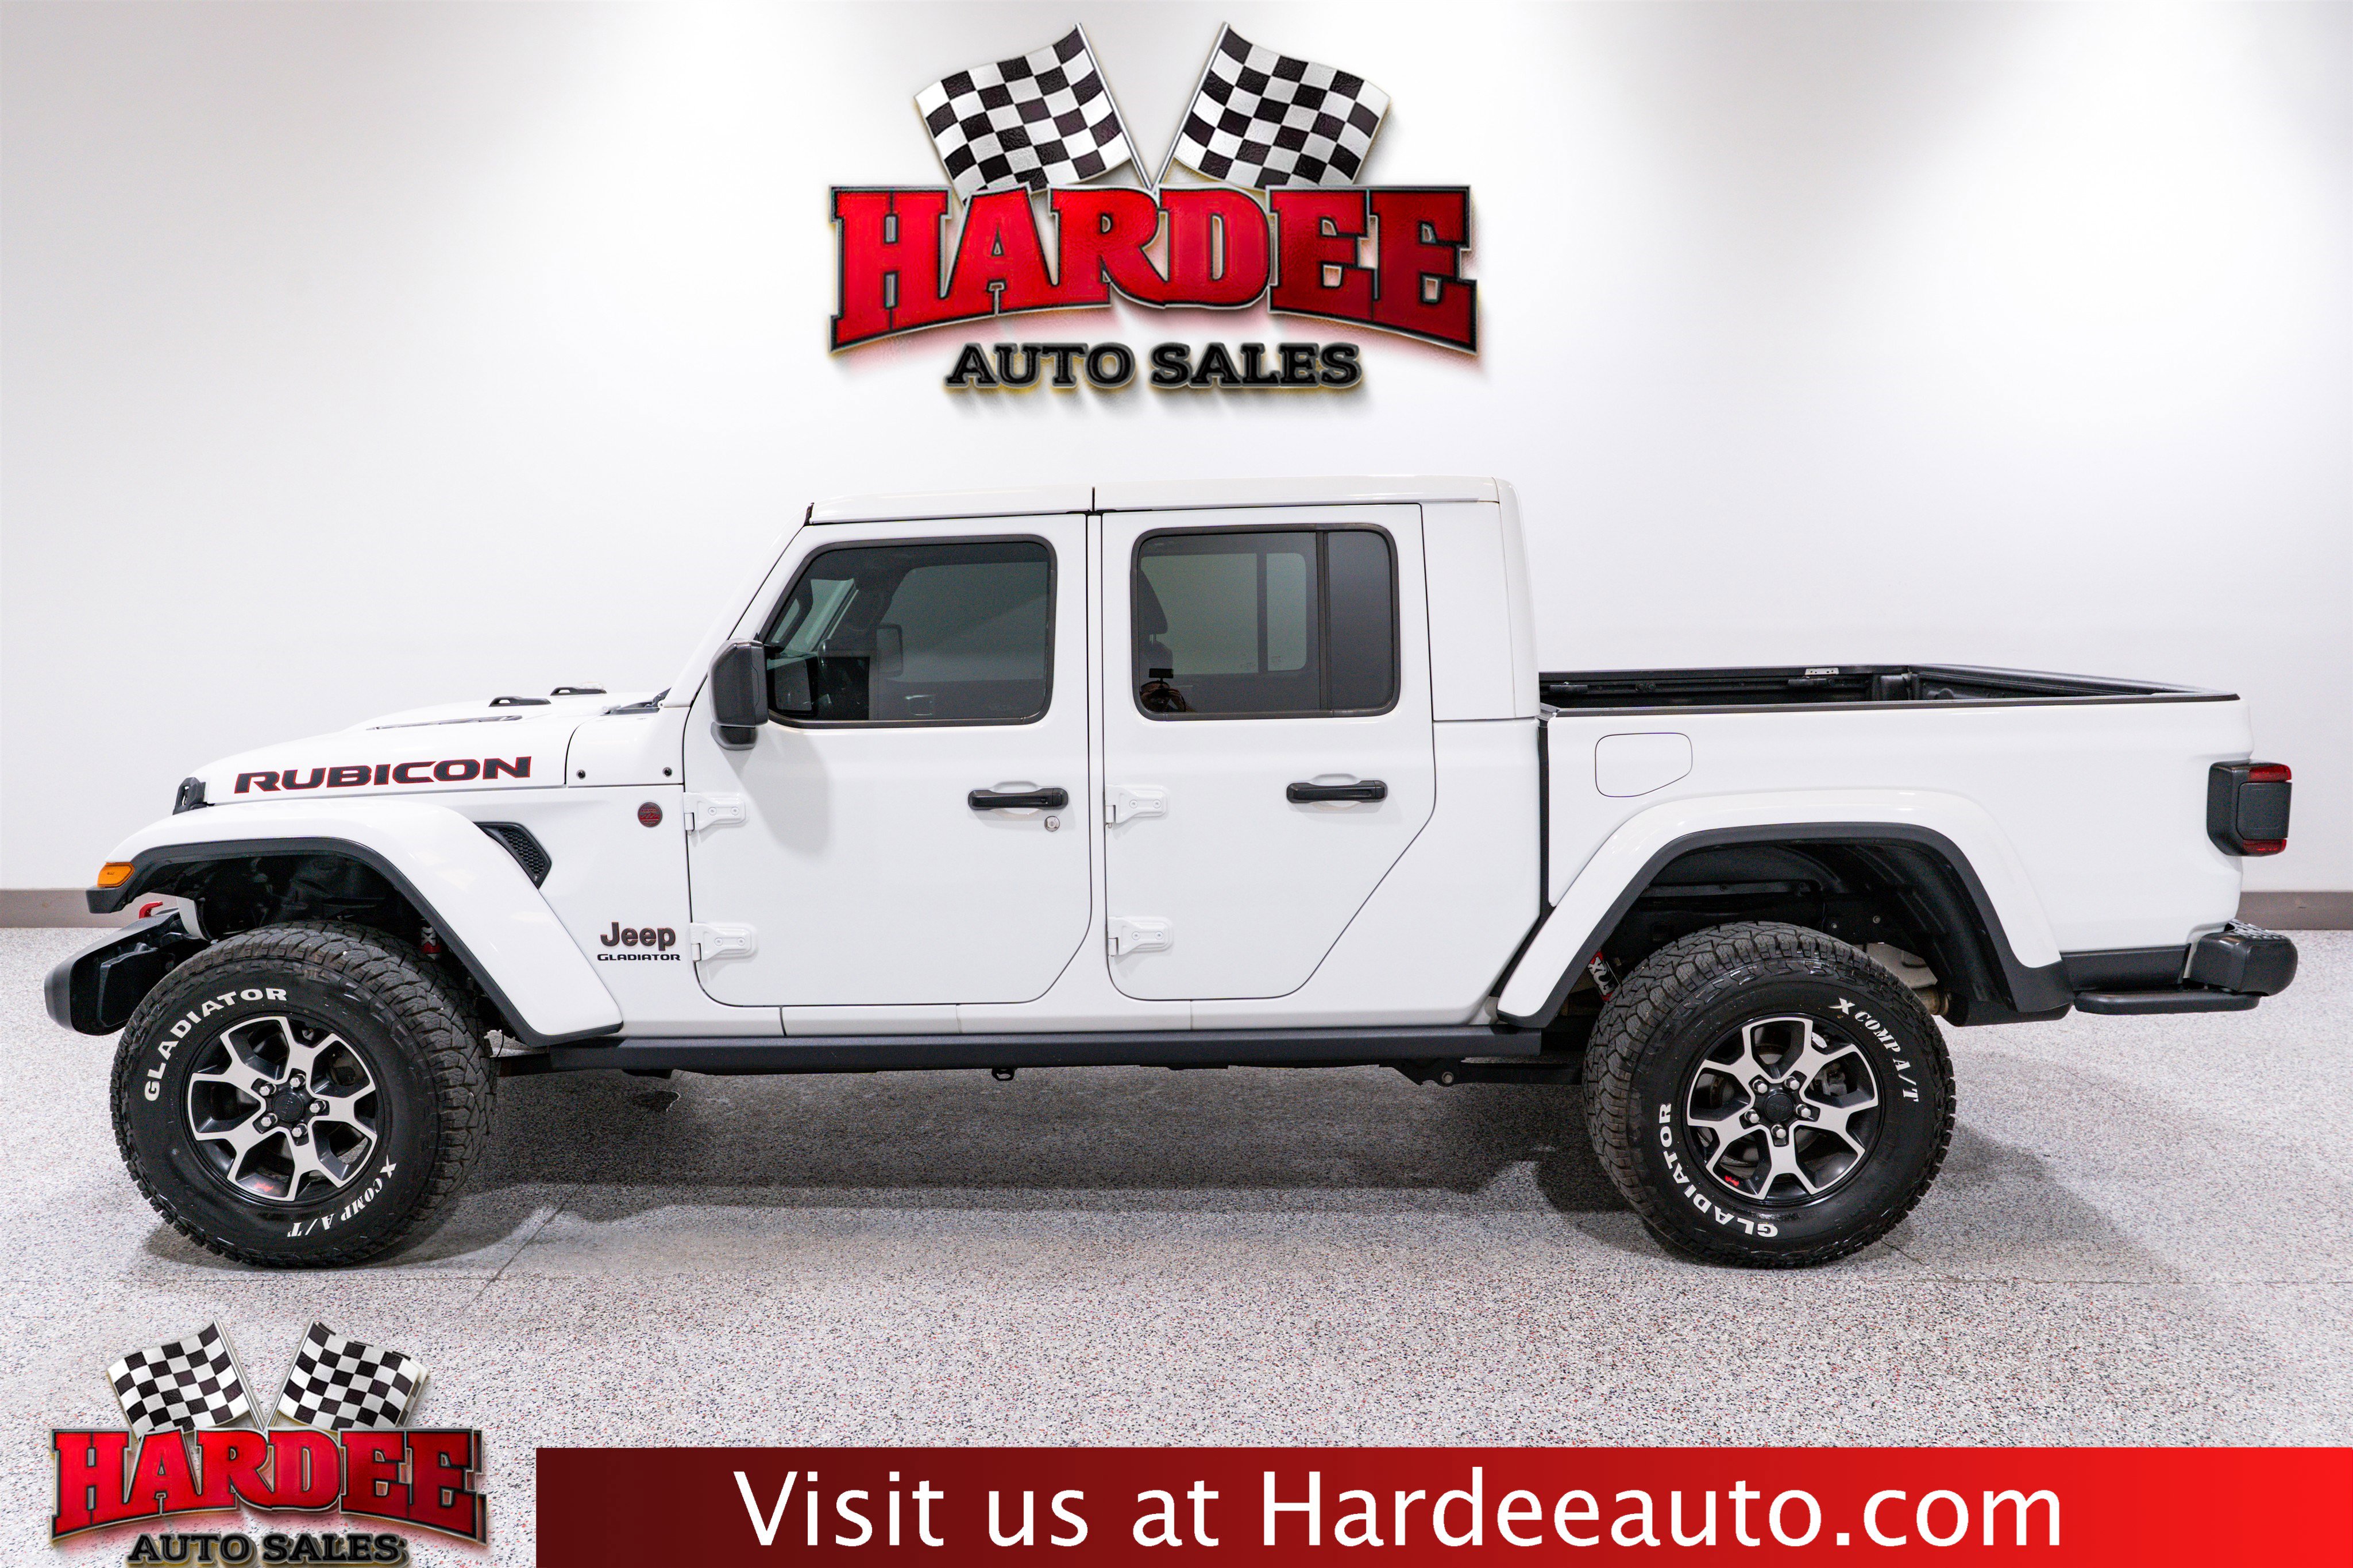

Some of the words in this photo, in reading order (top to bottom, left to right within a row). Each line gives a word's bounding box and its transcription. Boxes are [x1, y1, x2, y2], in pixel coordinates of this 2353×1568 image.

[829, 184, 1479, 355] HARDEE
[946, 342, 1136, 389] AUTO
[1150, 342, 1363, 389] SALES
[234, 756, 532, 794] RUBICON
[596, 953, 681, 961] GLADIATOR
[599, 921, 676, 952] Jeep
[144, 987, 287, 1101] GLADIATOR
[1854, 1010, 1902, 1054] COMP
[1892, 1057, 1919, 1103] A/T
[1659, 1103, 1779, 1238] GLADIATOR
[340, 1177, 384, 1222] COMP
[287, 1212, 339, 1238] A/T
